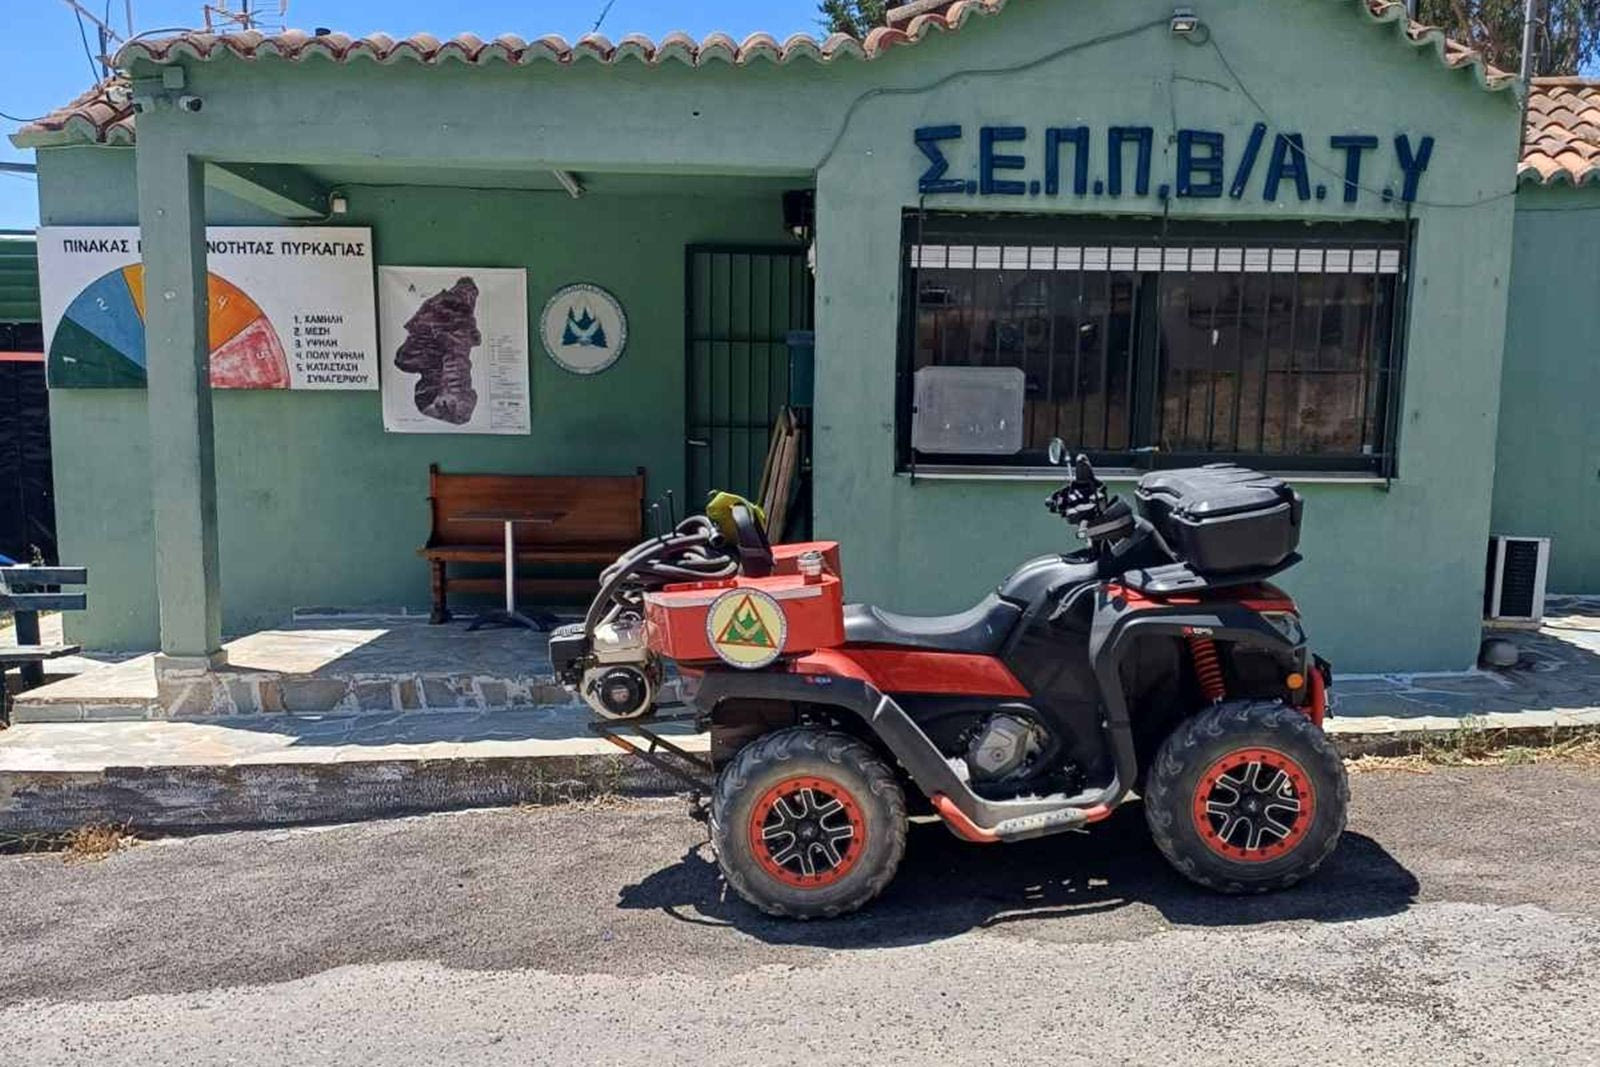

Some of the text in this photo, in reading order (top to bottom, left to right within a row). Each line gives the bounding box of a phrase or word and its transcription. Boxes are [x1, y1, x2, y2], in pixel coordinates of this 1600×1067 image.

[914, 122, 1435, 202] Σ.Ε.Π.Π.Β/Α.Τ.Υ
[63, 239, 129, 254] ΠΙΝΑΚΑΣ
[205, 241, 274, 255] ΝΟΤΗΤΑΣ
[281, 241, 365, 257] ΠΥΡΚΑΓΙΑΣ
[304, 327, 330, 336] ΜΕΣΗ
[305, 351, 330, 360] ΠΟΛΥ
[305, 362, 359, 372] ΚΑΤΑΣΤΑΣΗ
[306, 374, 369, 384] ΣΥΝΑΓΕΡΜΟΥ
